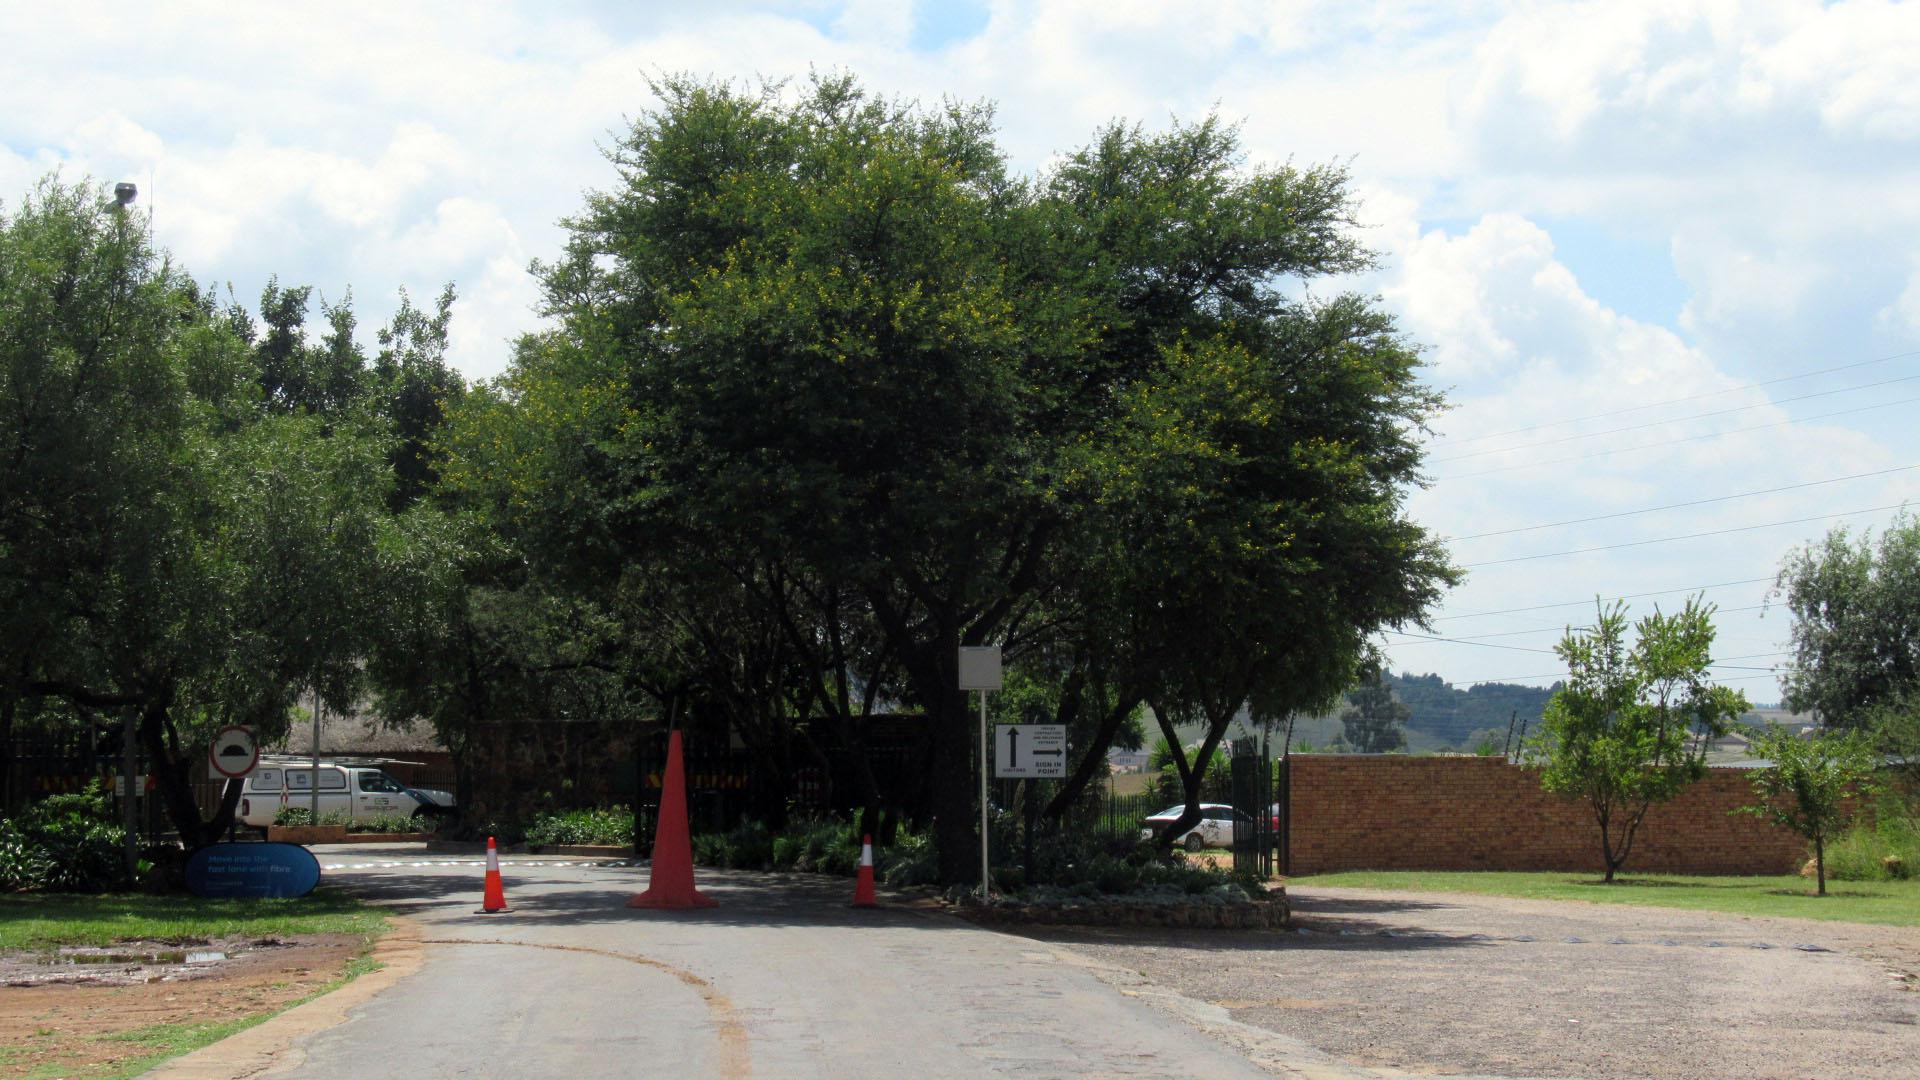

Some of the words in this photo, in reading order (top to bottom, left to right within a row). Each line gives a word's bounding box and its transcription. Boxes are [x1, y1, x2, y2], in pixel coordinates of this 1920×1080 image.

[208, 855, 233, 863] Move
[234, 855, 252, 863] into
[253, 855, 269, 863] the
[208, 864, 226, 873] fast
[228, 864, 248, 873] lane
[249, 864, 268, 873] with
